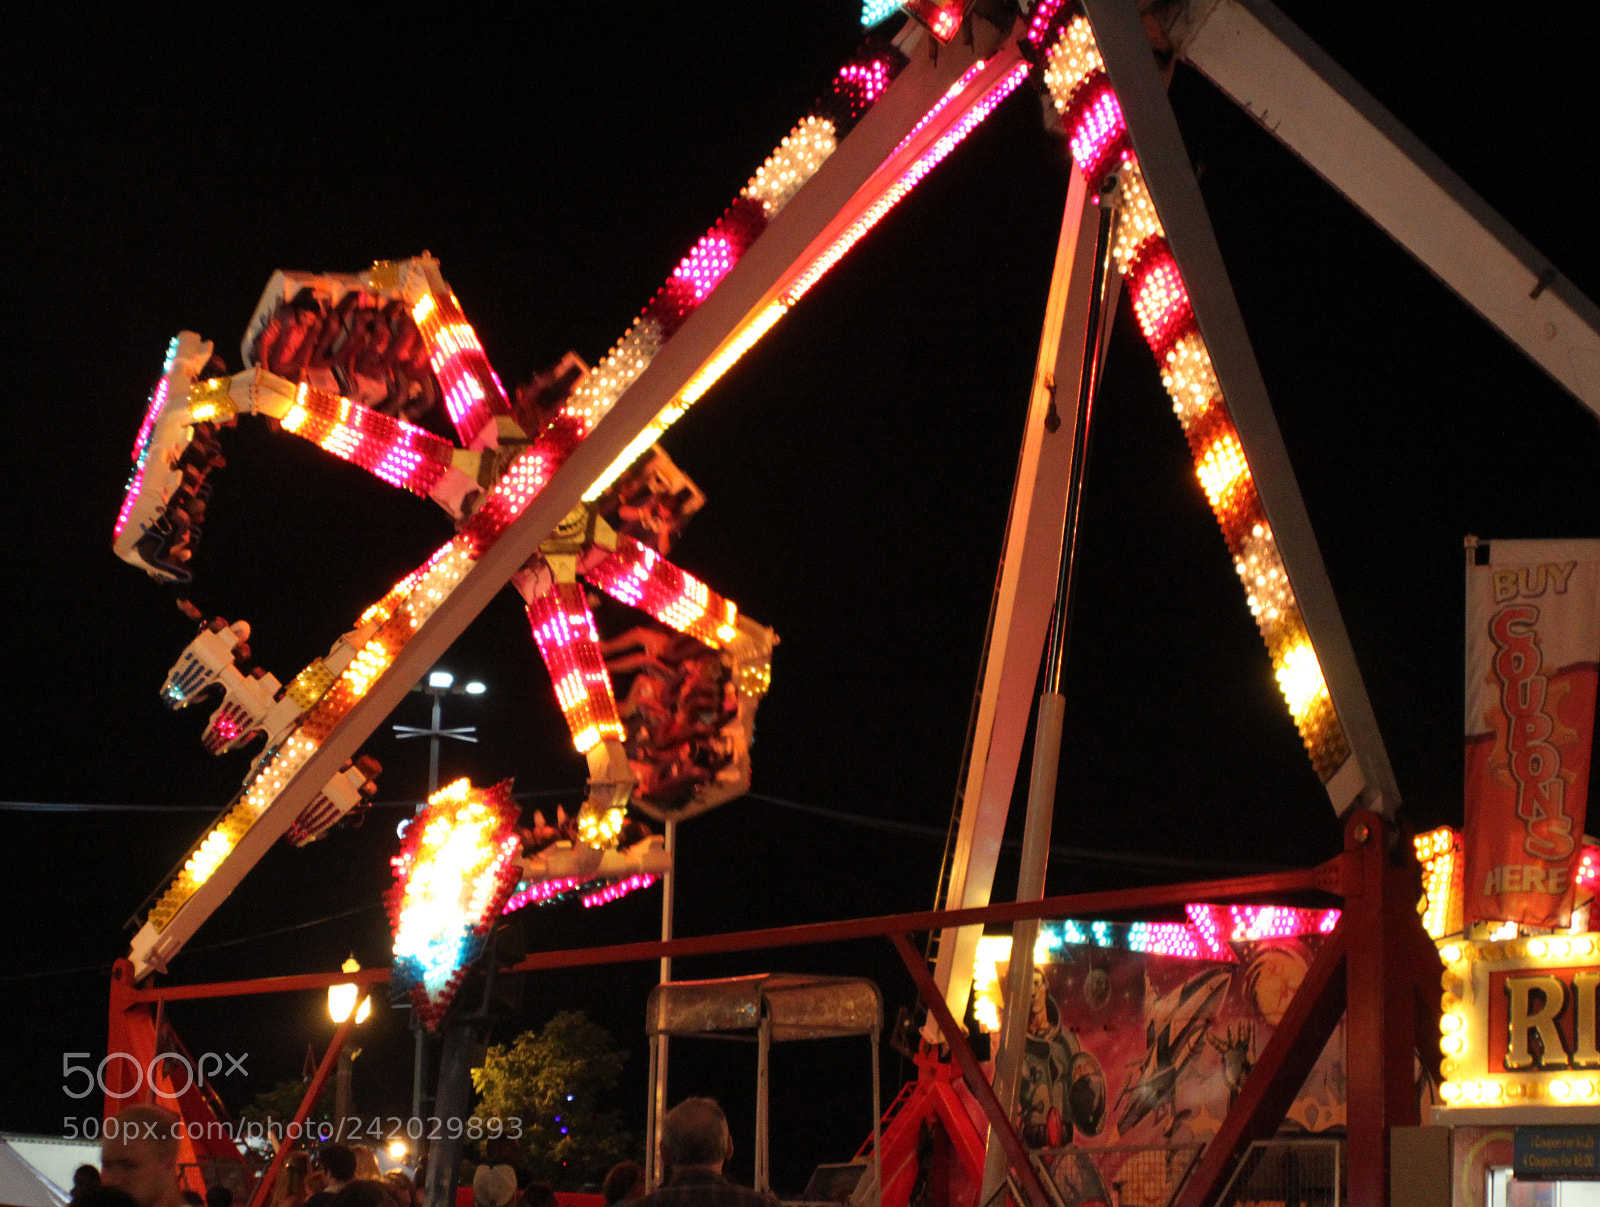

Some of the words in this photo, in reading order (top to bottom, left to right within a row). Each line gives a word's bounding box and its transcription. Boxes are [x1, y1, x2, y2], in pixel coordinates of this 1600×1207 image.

[1493, 560, 1578, 602] BUY
[1488, 604, 1576, 861] COUPONS
[1483, 865, 1569, 897] HERE
